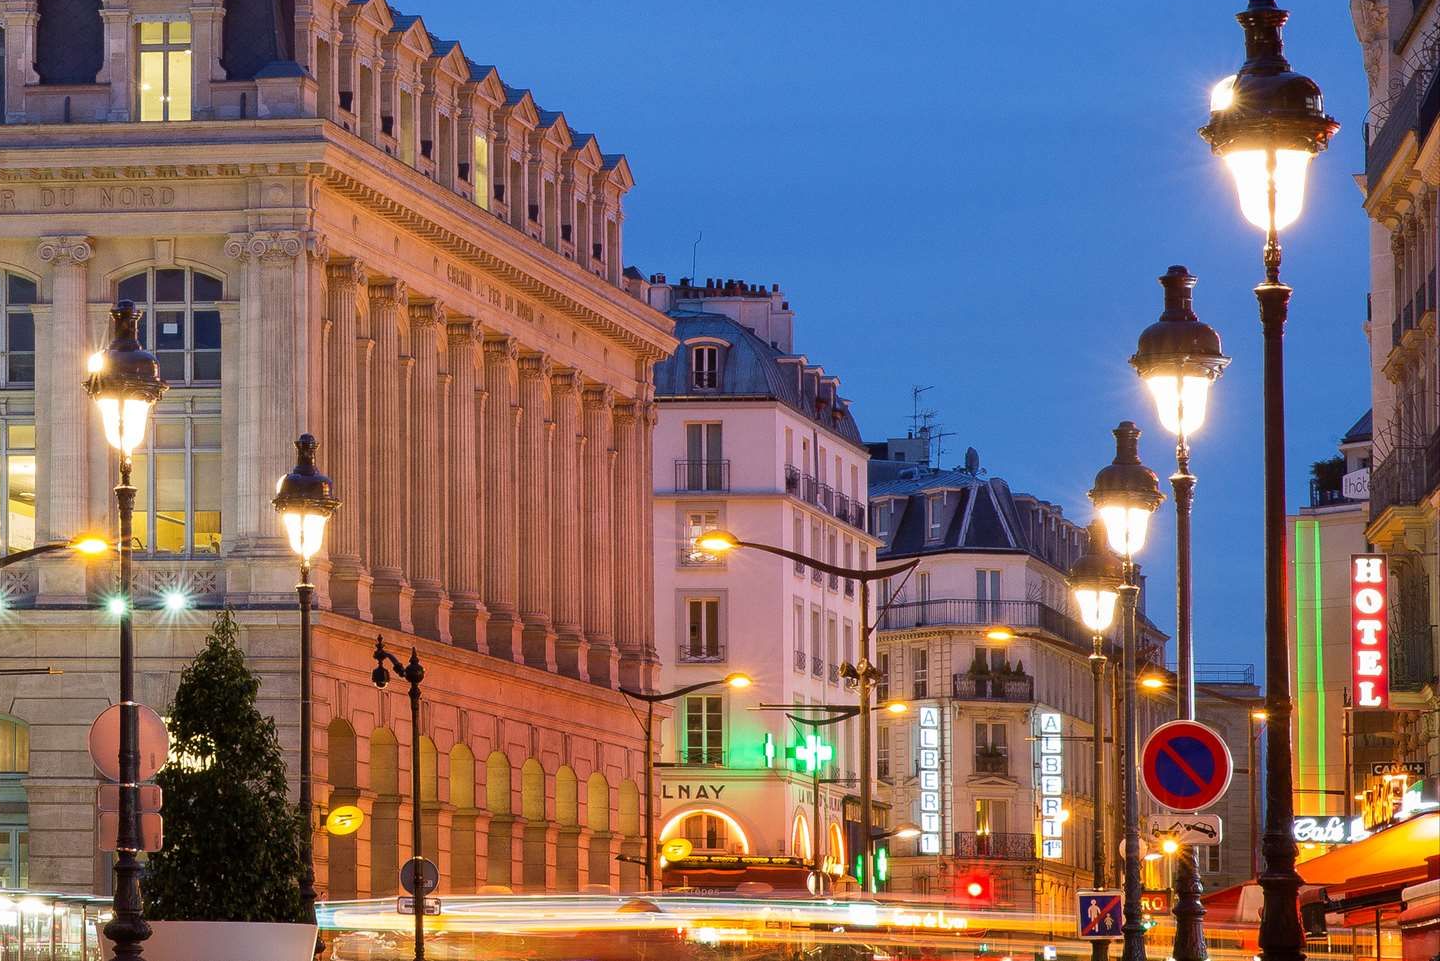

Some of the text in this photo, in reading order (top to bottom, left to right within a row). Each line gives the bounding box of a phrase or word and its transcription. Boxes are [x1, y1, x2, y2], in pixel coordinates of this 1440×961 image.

[40, 188, 75, 208] DU
[100, 186, 175, 208] NORD
[1355, 558, 1383, 707] HOTEL
[922, 709, 936, 830] ALBERT
[1043, 715, 1058, 835] ALBERT
